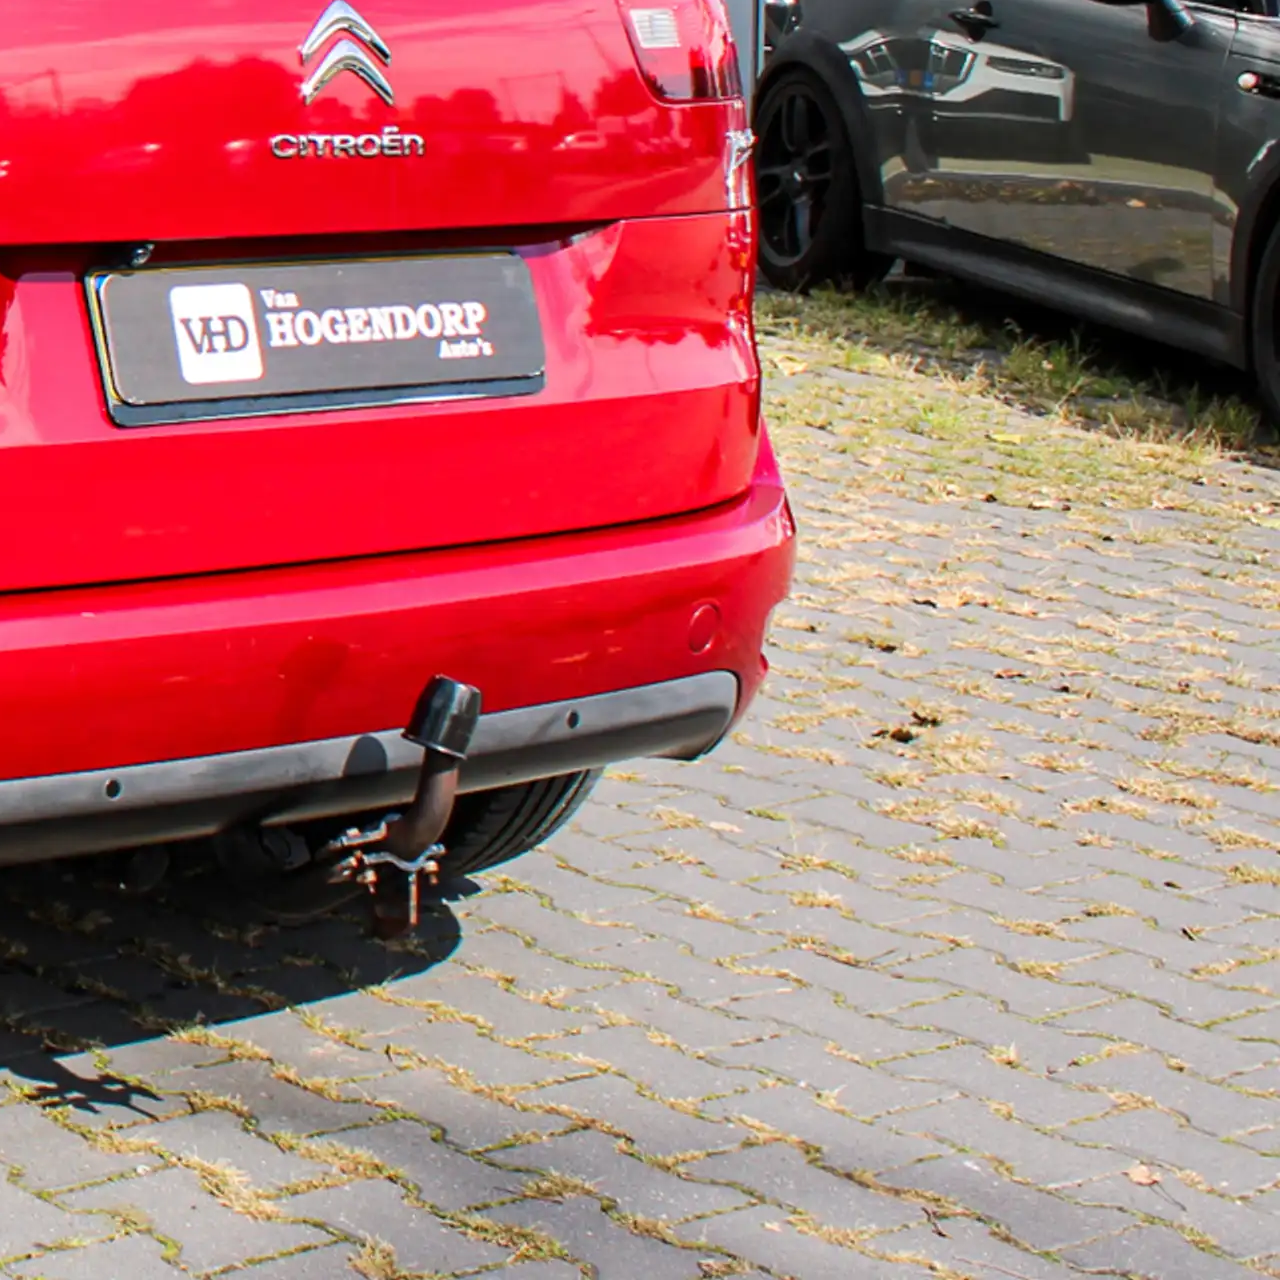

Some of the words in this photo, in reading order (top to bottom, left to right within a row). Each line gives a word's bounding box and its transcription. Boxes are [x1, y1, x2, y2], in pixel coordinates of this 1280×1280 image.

[260, 289, 300, 308] Van
[179, 314, 250, 354] VHD
[267, 302, 487, 348] HOGENDORP
[438, 337, 494, 360] Auto's
